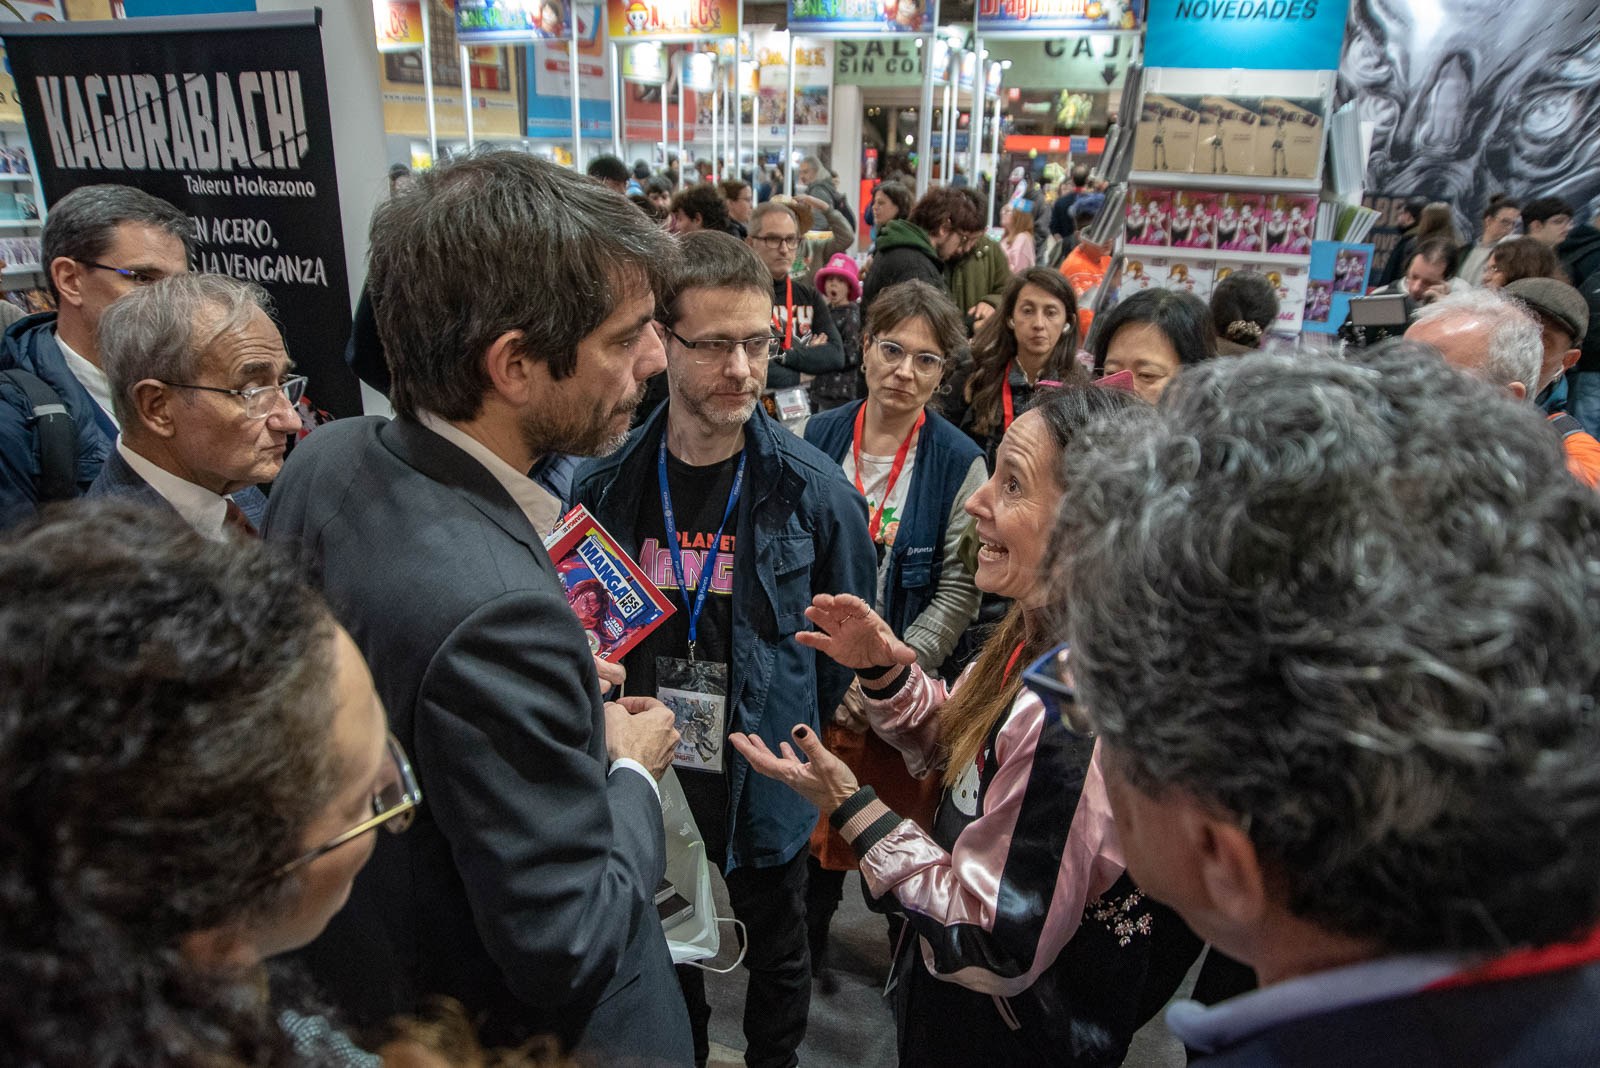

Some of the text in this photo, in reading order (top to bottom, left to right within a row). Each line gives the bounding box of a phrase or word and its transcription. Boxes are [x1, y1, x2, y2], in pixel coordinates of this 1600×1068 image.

[1175, 0, 1317, 20] NOVEDADES
[839, 59, 875, 74] SIN
[36, 70, 309, 170] KAGURABACHI
[183, 175, 317, 198] Takeru Hokazono
[212, 217, 280, 250] ACERO,
[221, 251, 329, 288] VENGANZA
[580, 540, 630, 601] MANGA
[619, 599, 633, 614] HO
[625, 593, 640, 610] ISS
